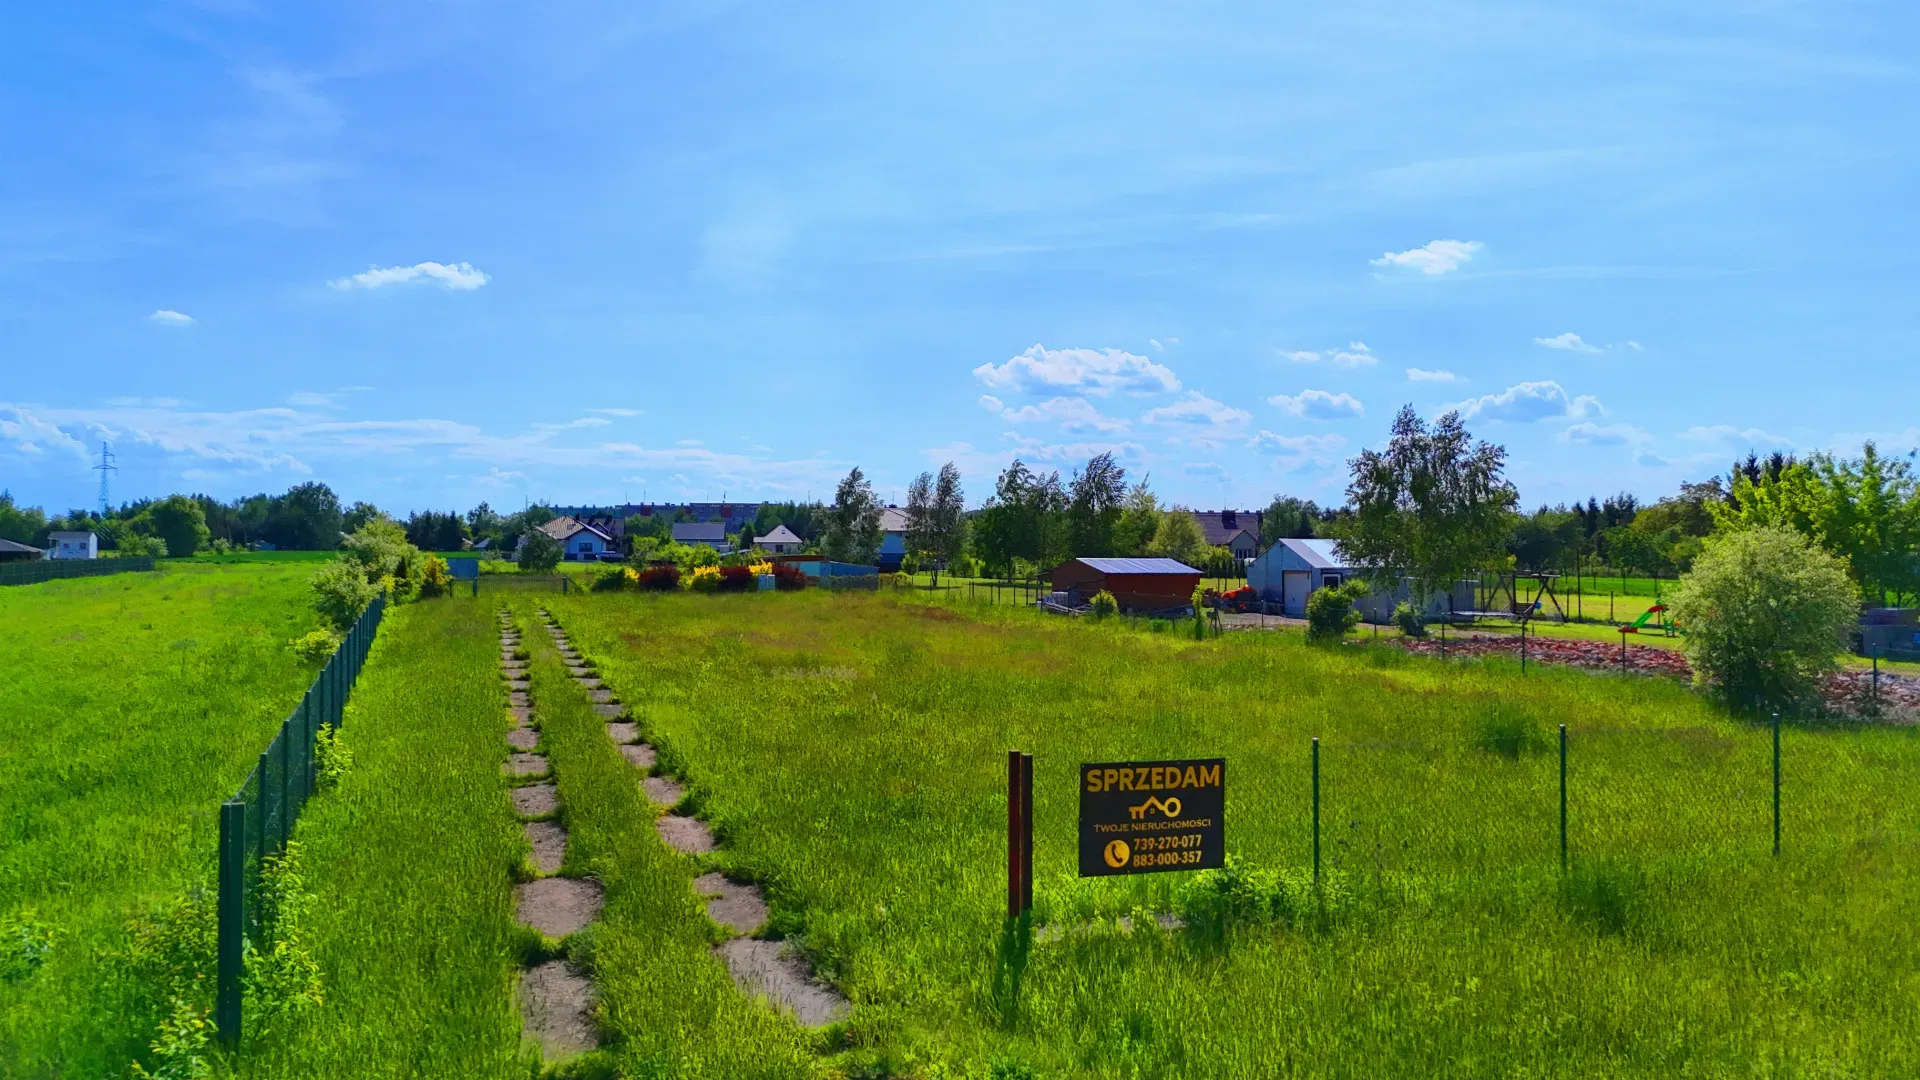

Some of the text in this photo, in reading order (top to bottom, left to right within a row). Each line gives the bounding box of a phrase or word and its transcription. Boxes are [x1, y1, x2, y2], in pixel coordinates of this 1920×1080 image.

[1087, 764, 1220, 792] SPRZEDAM
[1094, 823, 1130, 833] TWOJE
[1133, 834, 1202, 850] 739-270-077
[1133, 850, 1202, 867] 883-000-357
